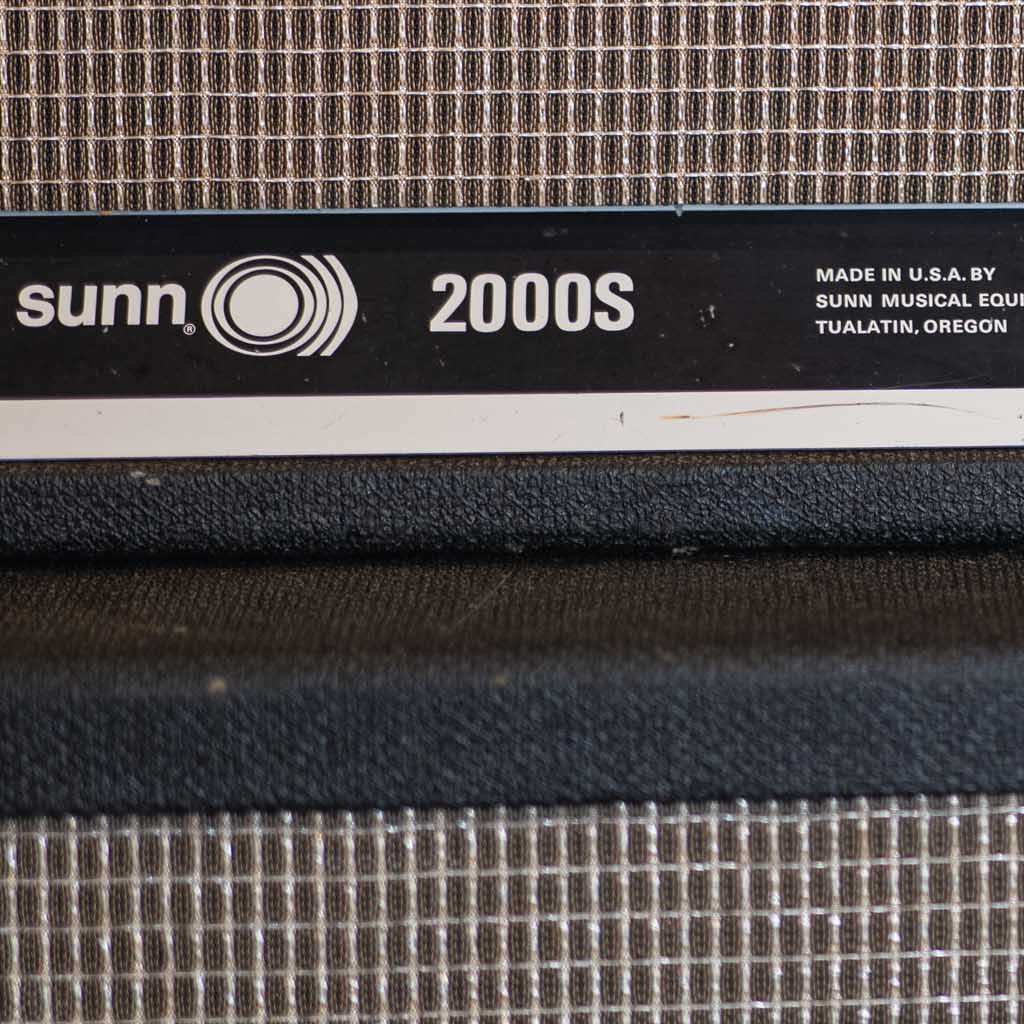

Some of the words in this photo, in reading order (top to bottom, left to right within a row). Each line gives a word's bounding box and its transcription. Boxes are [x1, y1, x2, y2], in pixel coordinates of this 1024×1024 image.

[815, 267, 876, 283] MADE
[882, 267, 902, 282] IN
[908, 266, 967, 282] U.S.A.
[970, 266, 997, 282] BY
[16, 282, 187, 328] sunn
[429, 272, 635, 333] 2000S
[815, 293, 873, 309] SUNN
[881, 292, 973, 308] MUSICAL
[815, 319, 920, 336] TUALATIN,
[923, 318, 1008, 335] OREGON
